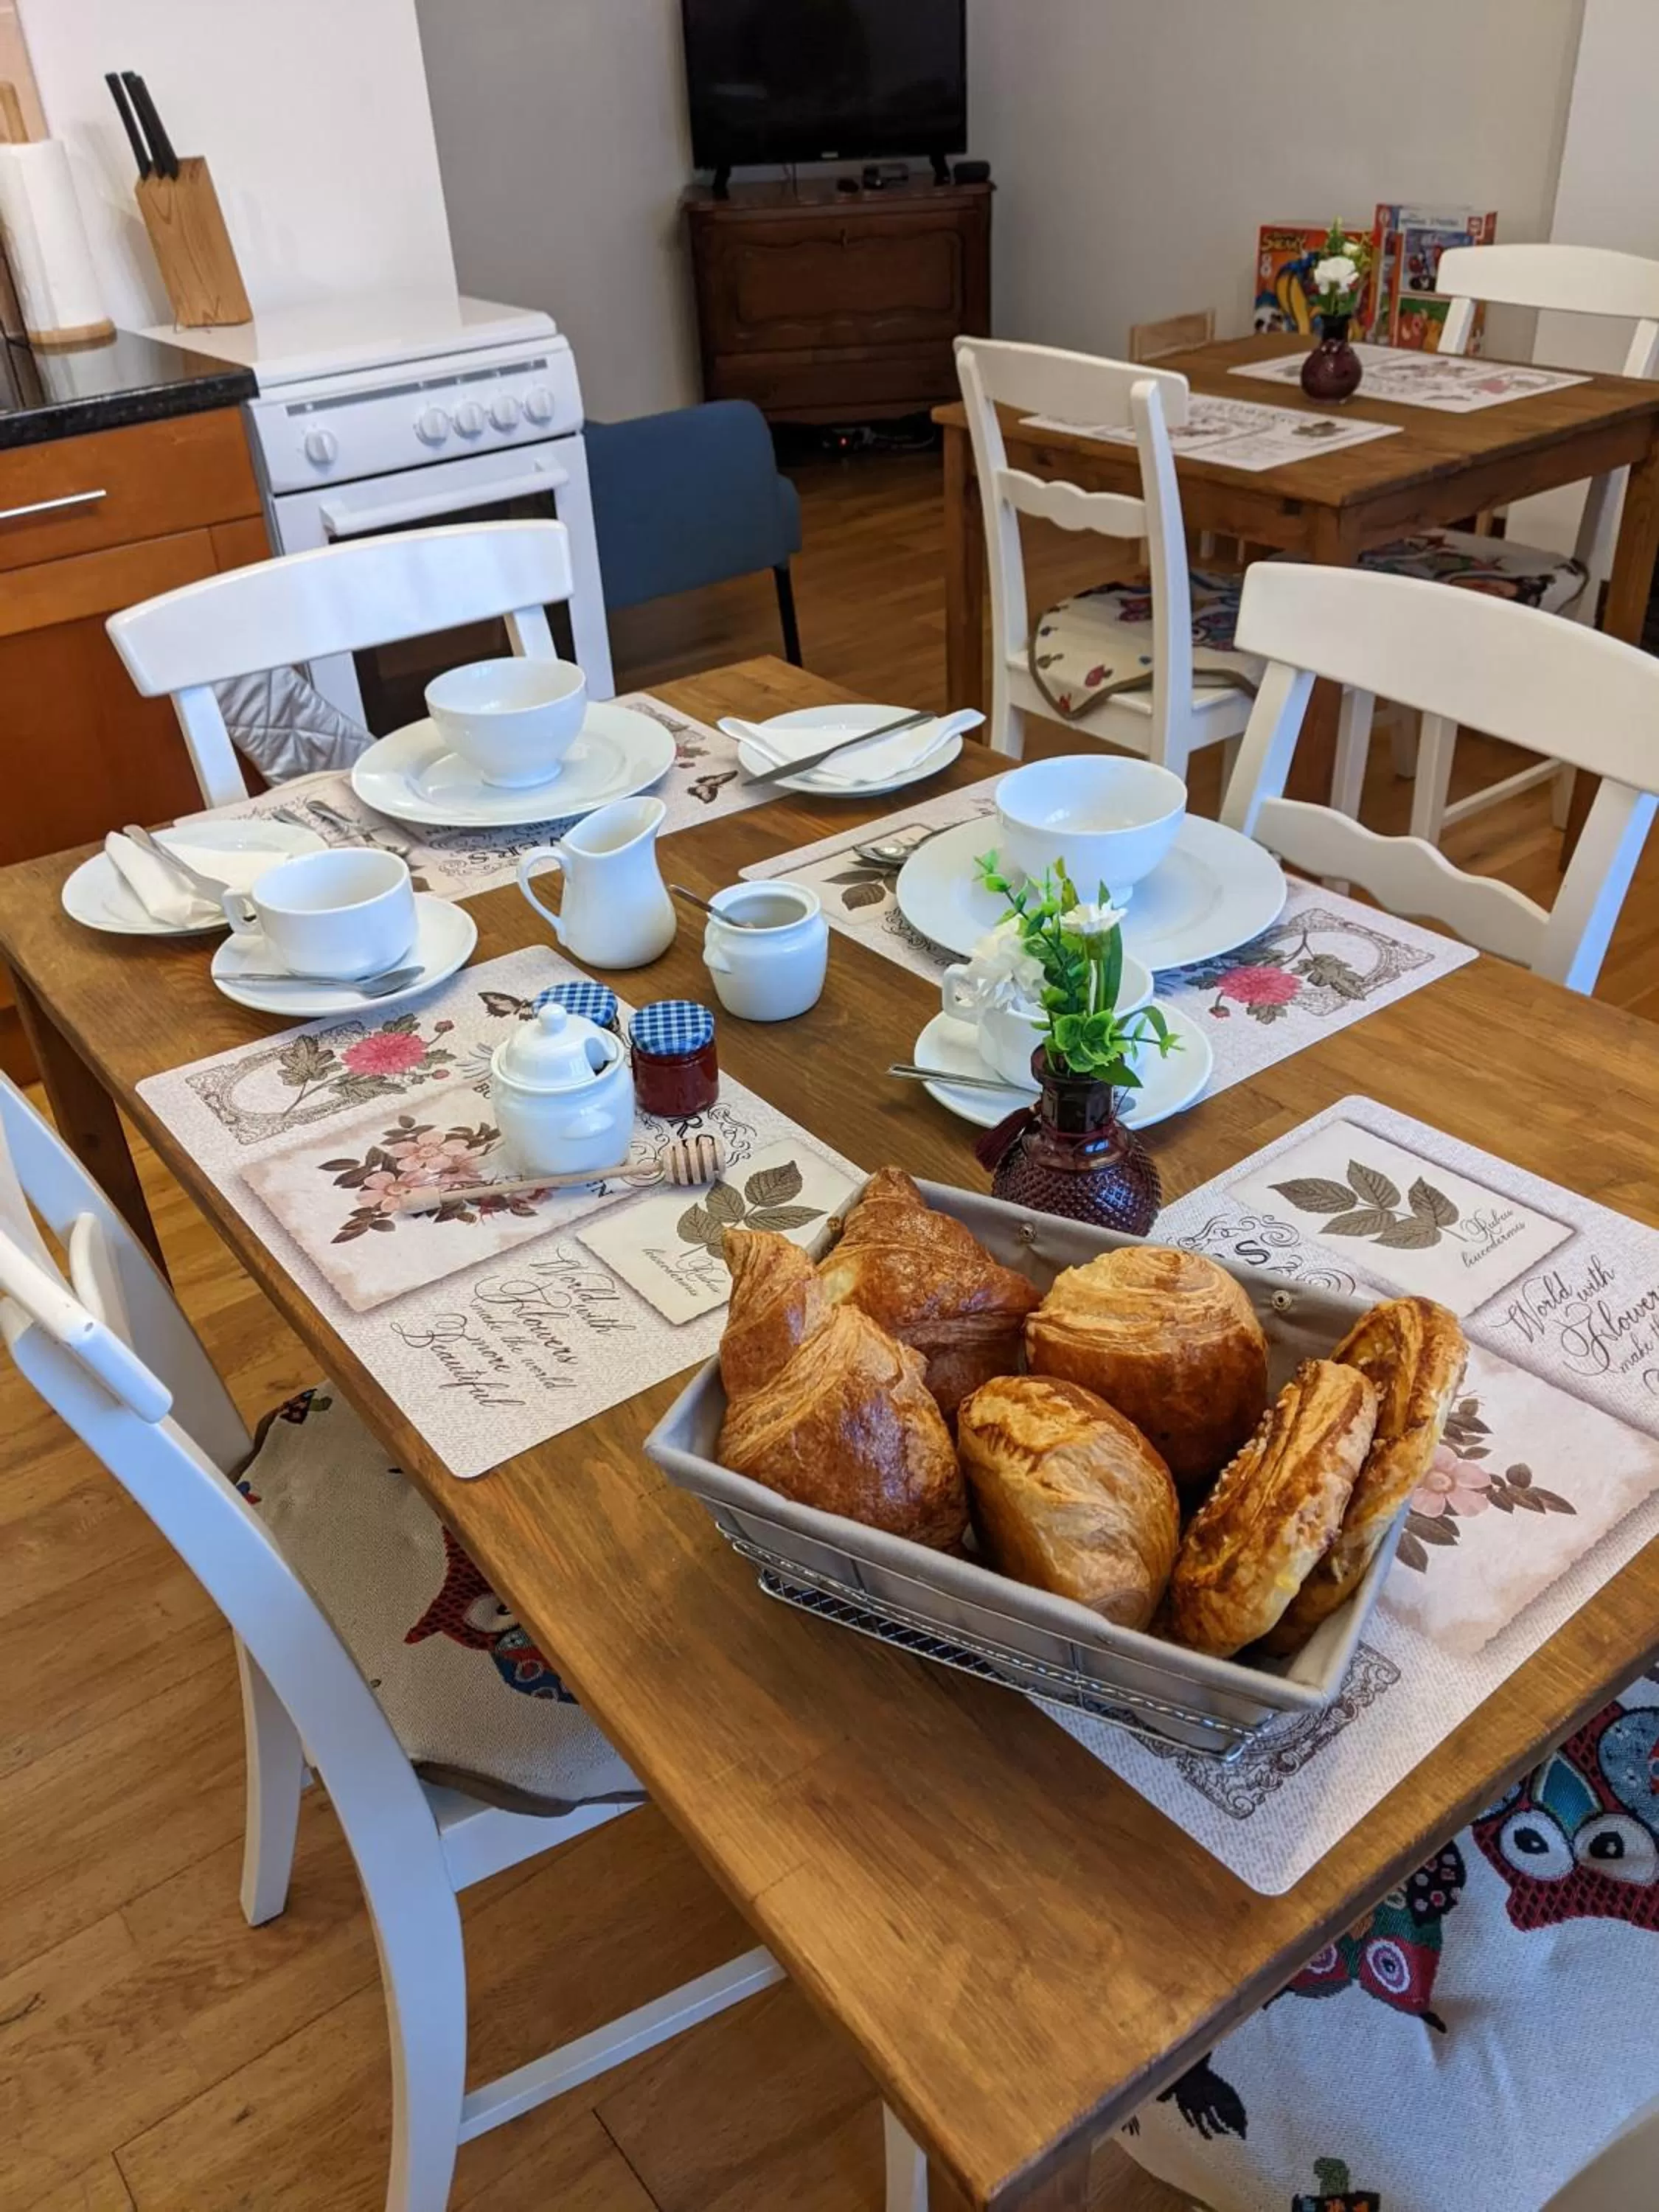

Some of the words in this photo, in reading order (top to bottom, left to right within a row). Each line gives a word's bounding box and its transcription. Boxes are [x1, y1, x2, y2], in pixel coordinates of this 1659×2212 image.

[529, 1248, 619, 1303] World
[570, 1303, 636, 1335] with
[1488, 1270, 1572, 1343] World
[1577, 1255, 1615, 1302] with
[389, 1313, 526, 1407] Beautiful
[463, 1335, 511, 1372] more
[470, 1296, 518, 1332] make
[501, 1337, 537, 1354] the
[521, 1358, 577, 1389] world
[475, 1276, 577, 1364] Flowers
[1550, 1287, 1659, 1376] Flower
[1620, 1332, 1654, 1374] make
